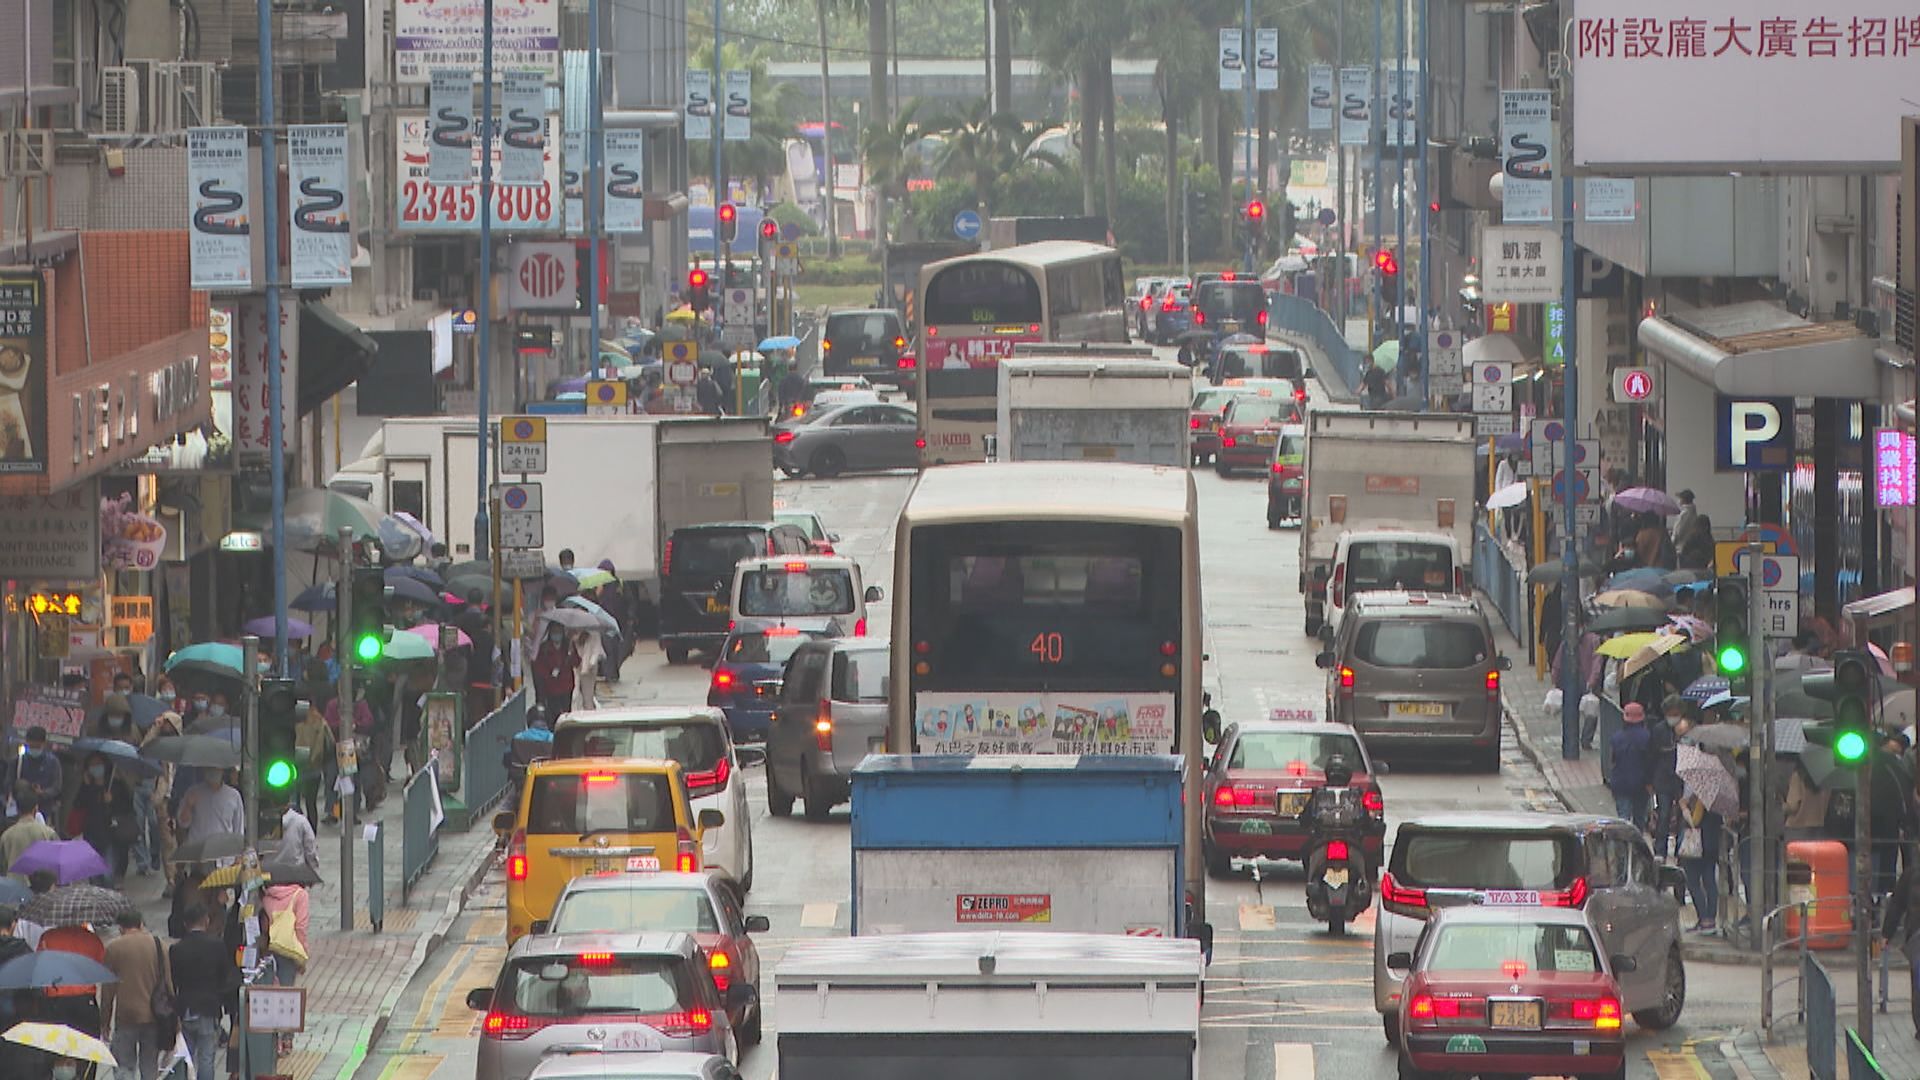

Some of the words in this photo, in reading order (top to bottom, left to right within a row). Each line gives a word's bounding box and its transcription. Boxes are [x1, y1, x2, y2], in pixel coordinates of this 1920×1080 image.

[1578, 15, 1920, 59] 附設龐大廣告招牌
[1502, 241, 1542, 260] 凱源
[1730, 401, 1782, 466] P
[507, 446, 522, 456] 24
[524, 446, 540, 456] hrs
[1768, 597, 1791, 611] hrs
[1030, 631, 1063, 663] 40
[1274, 708, 1314, 720] TAXI
[629, 859, 658, 869] TAXI
[977, 896, 1009, 910] ZEPRO
[1488, 891, 1537, 904] TAXI
